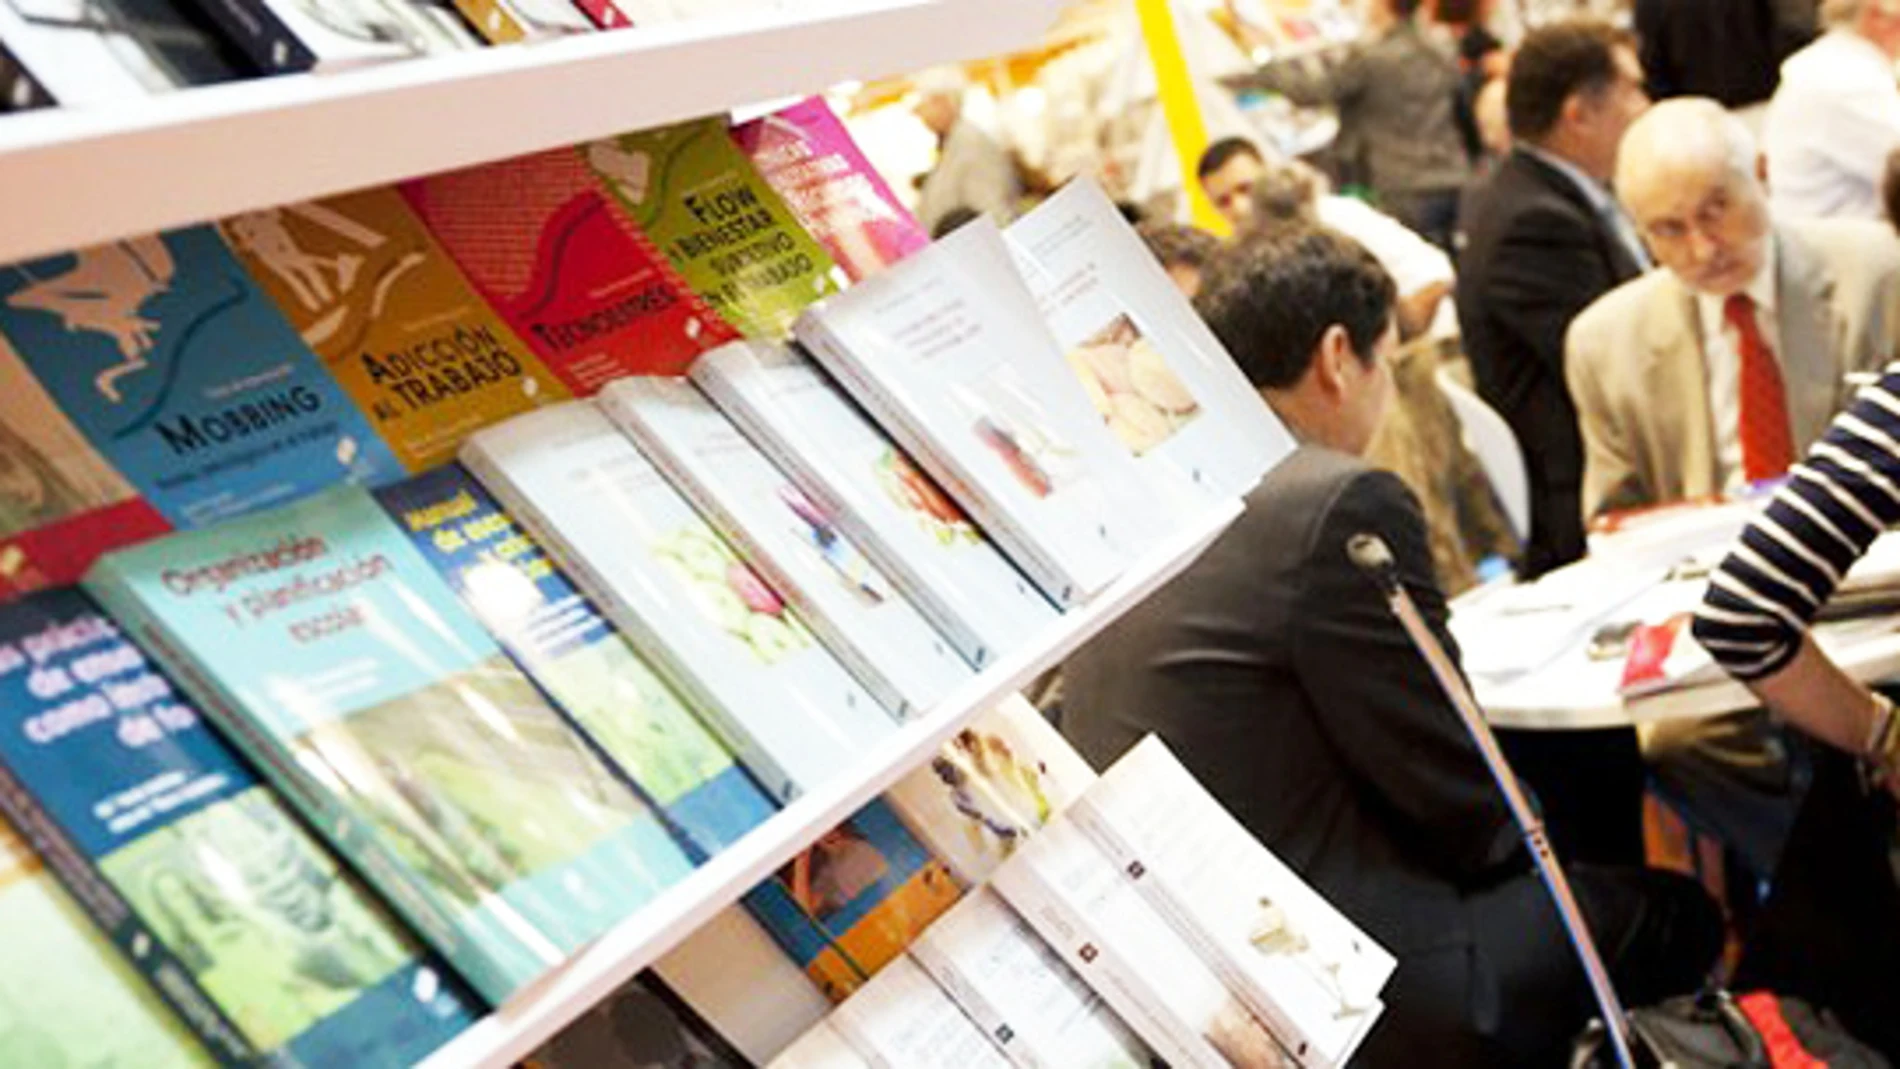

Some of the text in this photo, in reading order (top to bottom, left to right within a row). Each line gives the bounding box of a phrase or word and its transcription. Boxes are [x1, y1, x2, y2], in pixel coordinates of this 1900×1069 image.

[682, 185, 759, 224] FLOW
[360, 323, 499, 385] ADICCIÓN
[391, 347, 523, 413] TRABAJO
[154, 385, 321, 456] MOBBING
[160, 533, 327, 597] Organización
[241, 553, 394, 620] planificación
